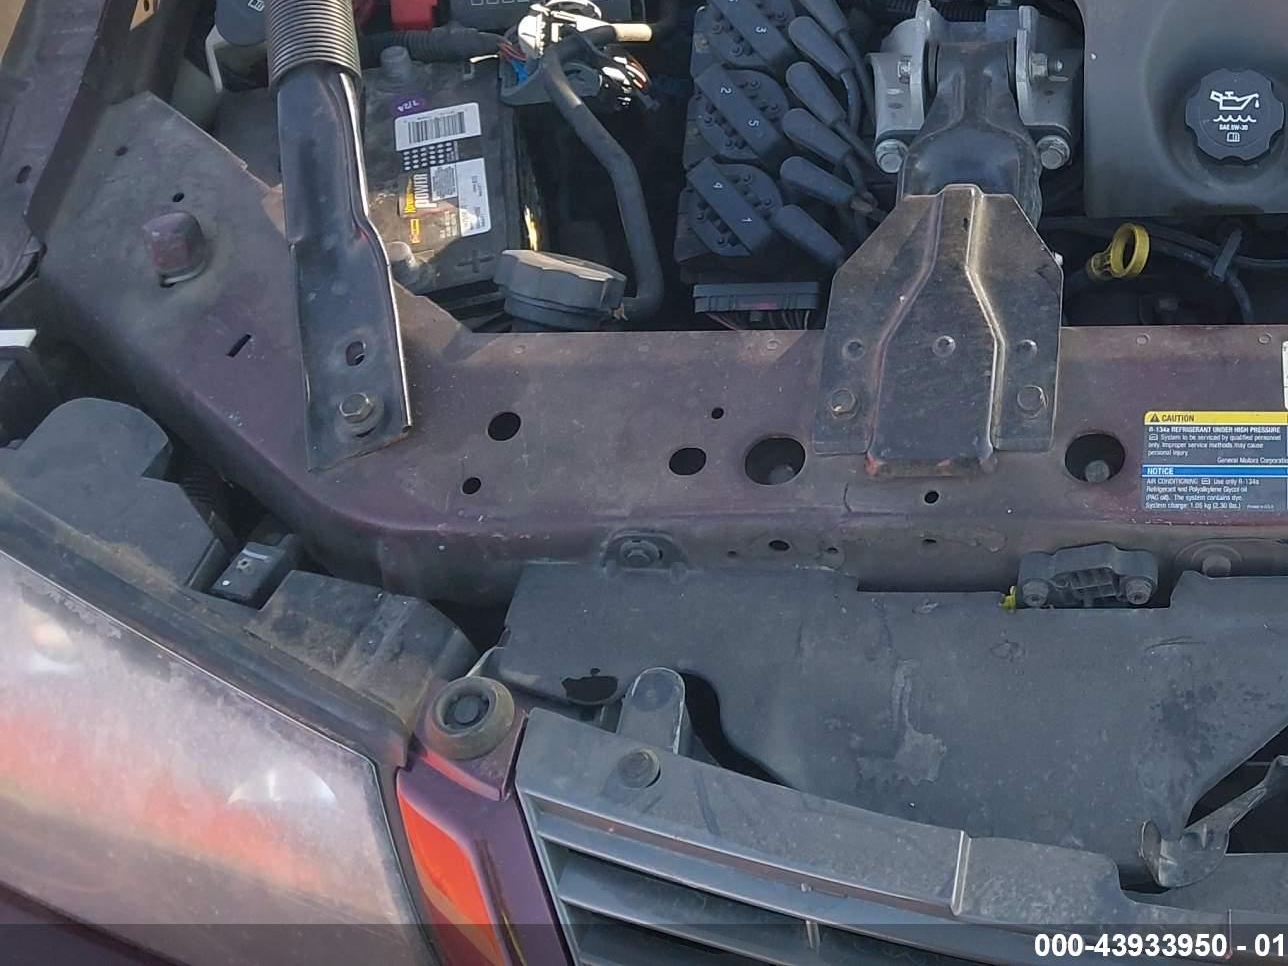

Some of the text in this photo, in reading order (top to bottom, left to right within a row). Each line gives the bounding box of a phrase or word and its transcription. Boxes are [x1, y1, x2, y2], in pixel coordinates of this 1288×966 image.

[720, 87, 732, 95] 2
[748, 119, 760, 127] 5
[1162, 414, 1195, 422] CAUTION
[1217, 457, 1238, 465] General
[1240, 457, 1258, 465] Motors
[1147, 467, 1174, 475] NOTICE
[1190, 502, 1203, 510] 1.05
[1204, 502, 1211, 510] kg
